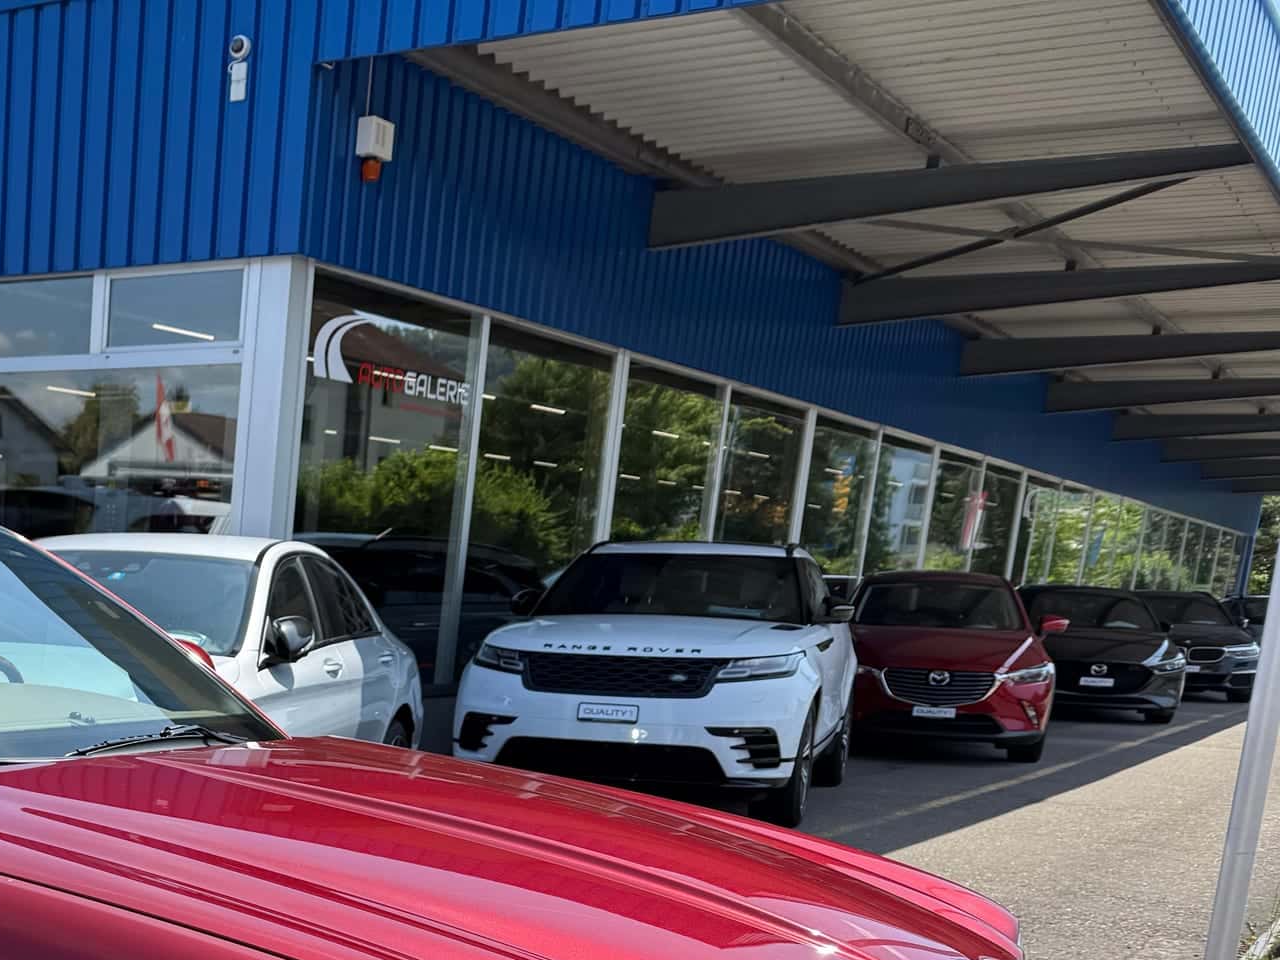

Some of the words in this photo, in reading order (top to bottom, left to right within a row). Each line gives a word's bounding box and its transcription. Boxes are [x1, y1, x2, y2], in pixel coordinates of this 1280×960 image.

[358, 362, 470, 405] AUTOGALERIE
[543, 642, 612, 651] RANGE
[627, 645, 702, 654] ROVER
